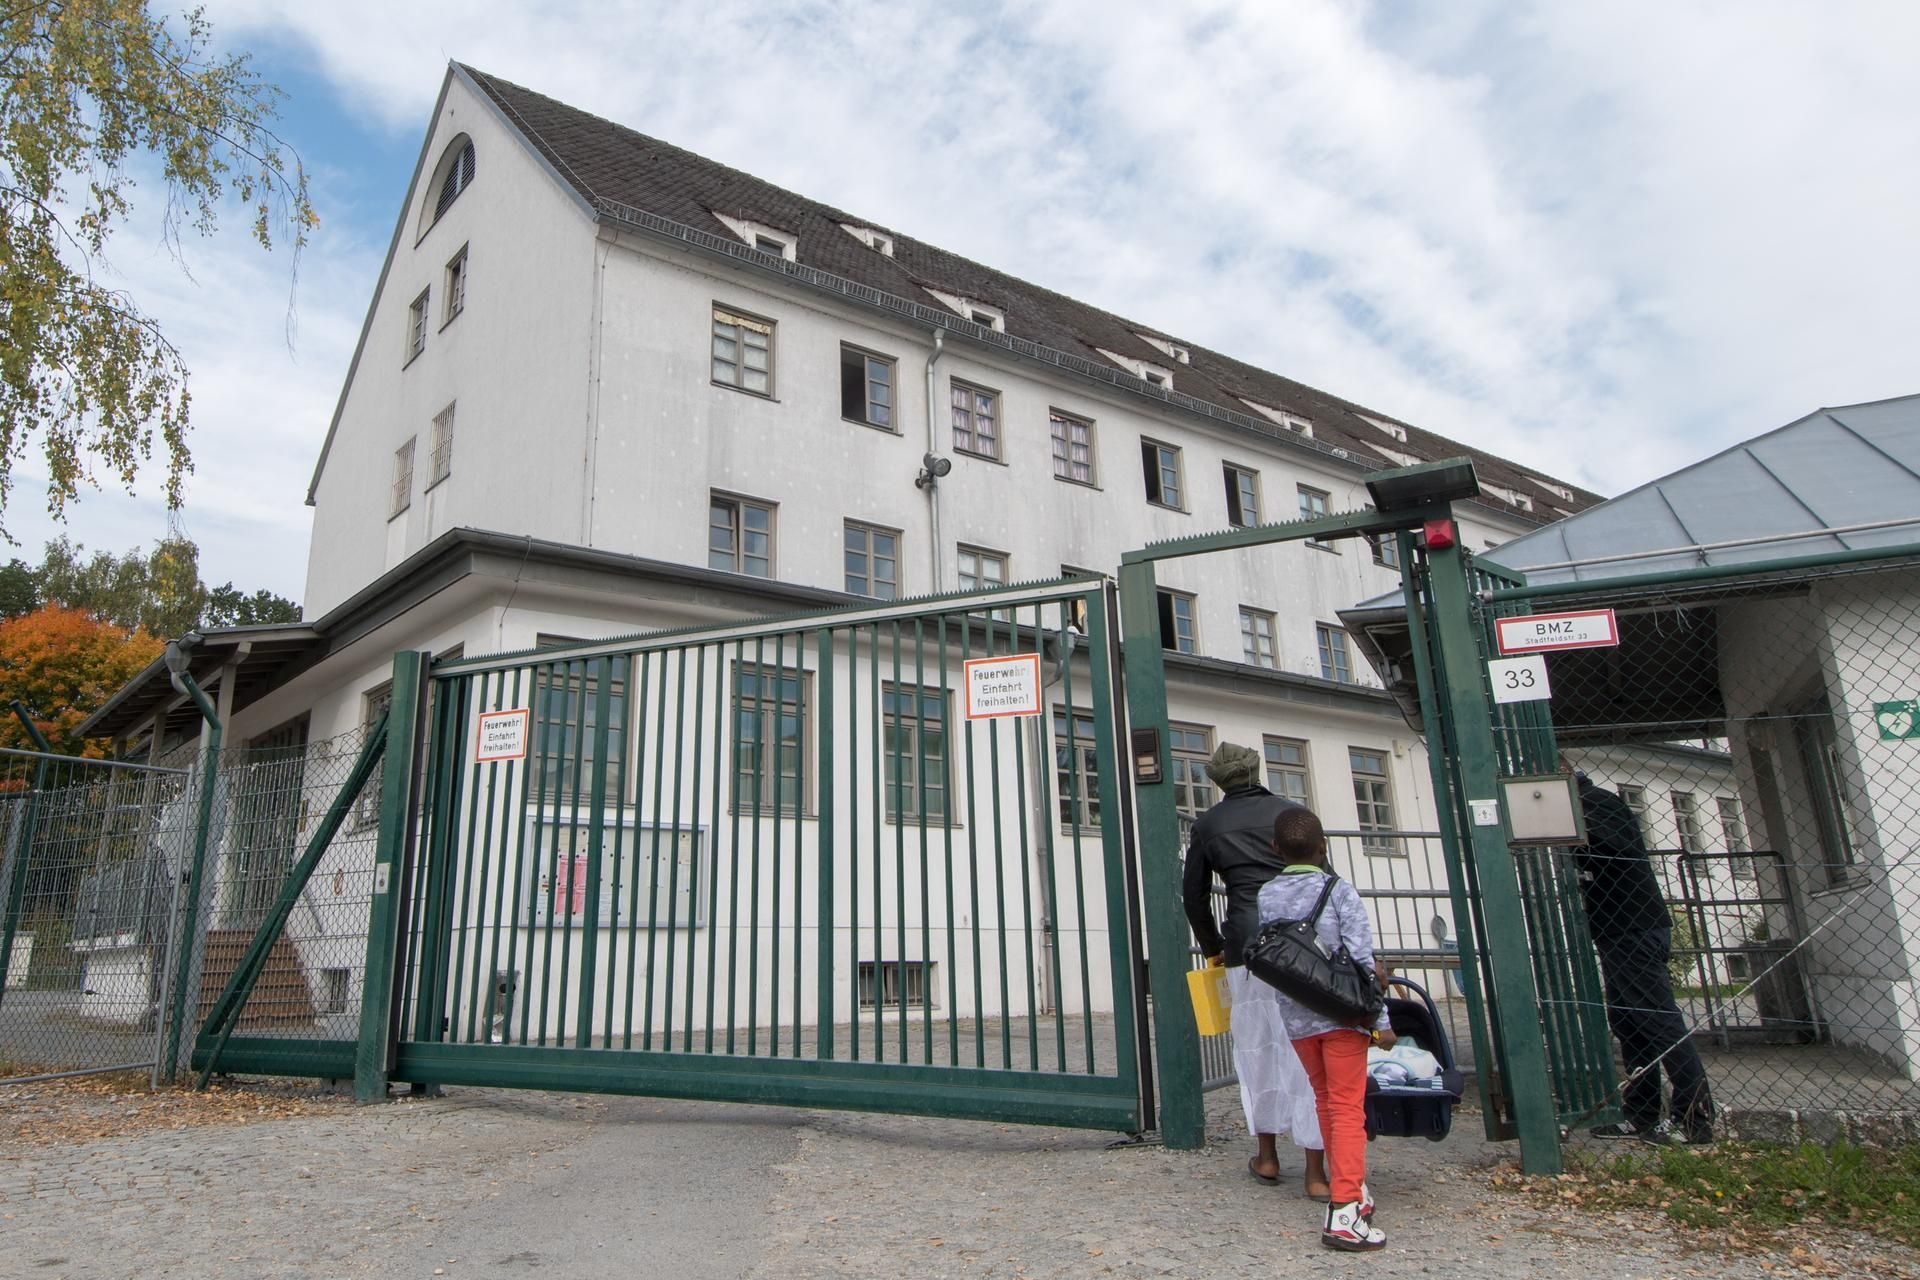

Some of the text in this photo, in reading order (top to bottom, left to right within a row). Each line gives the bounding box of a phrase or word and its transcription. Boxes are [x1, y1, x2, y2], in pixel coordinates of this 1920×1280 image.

[1536, 621, 1574, 635] BMZ
[1504, 669, 1536, 689] 33
[982, 682, 1022, 694] Einfahrt
[977, 693, 1029, 708] freihalten!
[488, 731, 516, 742] Einfahrt
